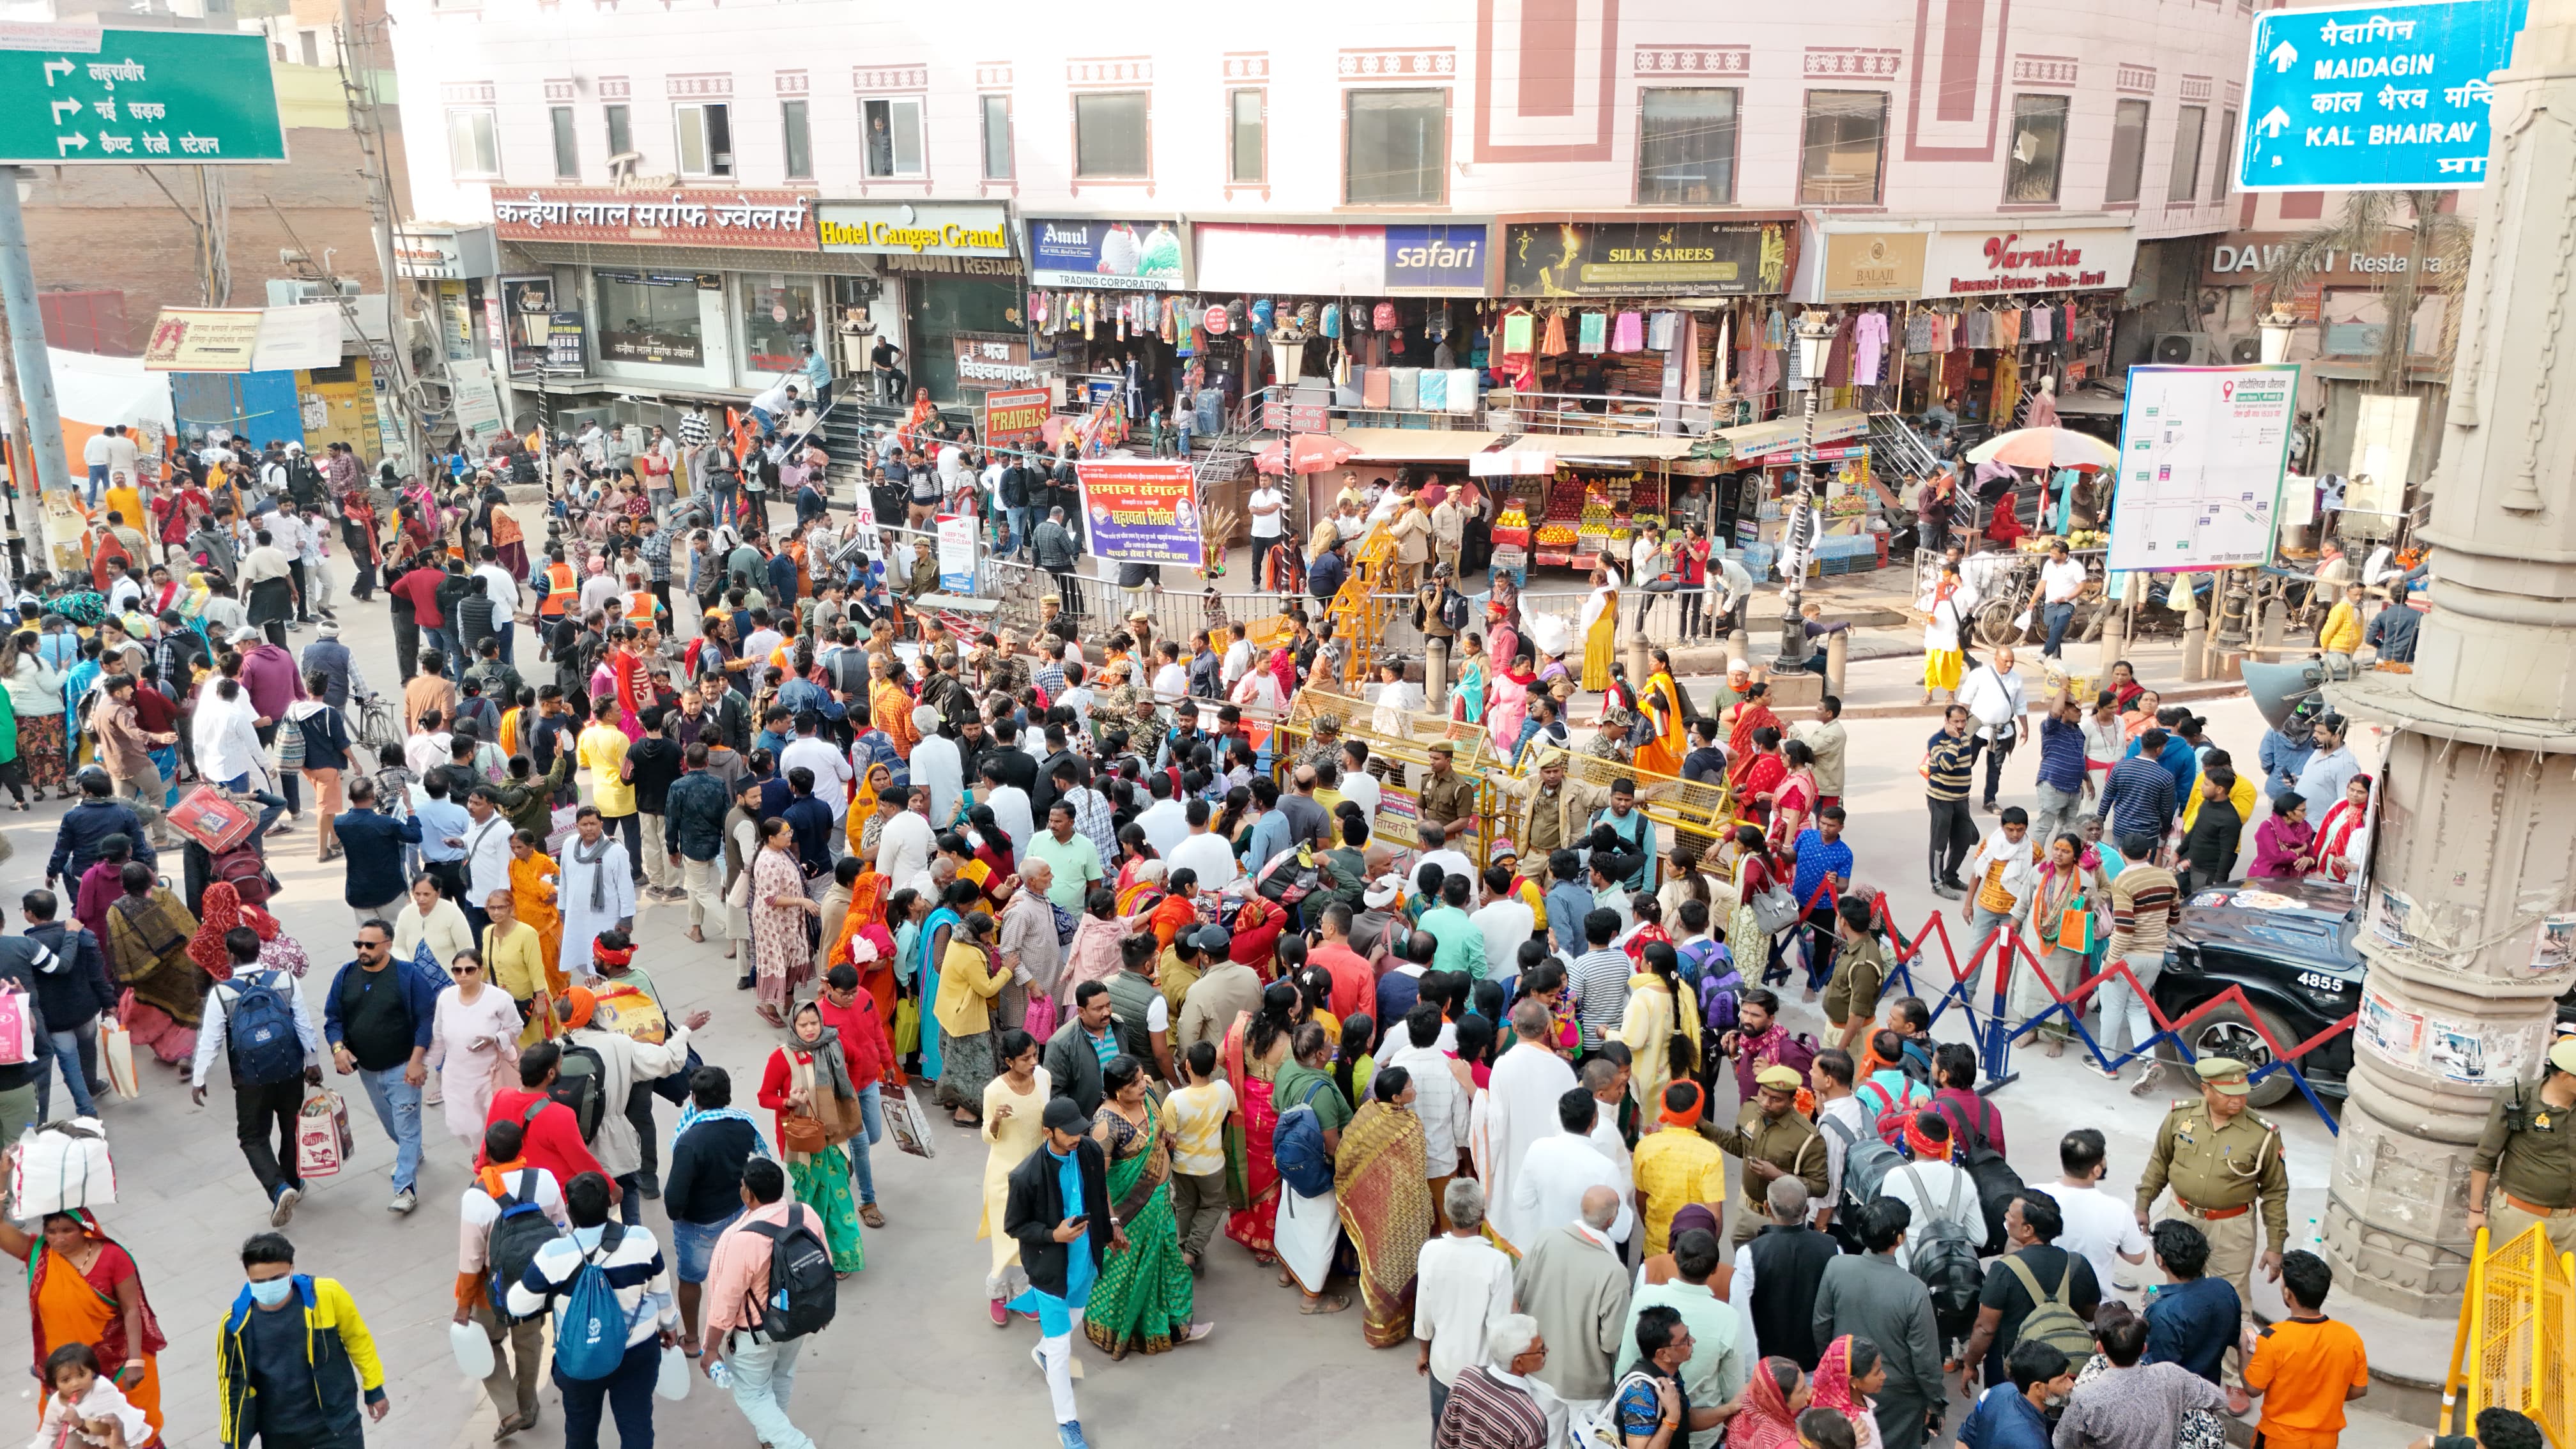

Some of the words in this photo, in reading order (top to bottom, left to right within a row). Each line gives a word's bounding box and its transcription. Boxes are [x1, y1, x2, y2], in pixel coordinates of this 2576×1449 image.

[49, 26, 100, 38] SCHEME
[2320, 15, 2416, 45] मैदागिन
[2313, 53, 2434, 80] MAIDAGIN
[93, 96, 116, 122] नई
[128, 103, 165, 123] सड़क
[2312, 91, 2362, 114] काल
[2377, 83, 2429, 111] भैरव
[2305, 126, 2356, 146] KAL
[2368, 121, 2478, 146] BHAIRAV
[495, 193, 568, 229] कन्हैया
[573, 203, 632, 226] लाल
[712, 196, 806, 231] ज्वेलर्स
[819, 220, 870, 244] Hotel
[873, 222, 939, 252] Ganges
[942, 224, 1006, 249] Grand
[1043, 224, 1087, 245] Amul
[1395, 241, 1477, 268] safari
[1609, 249, 1646, 262] SILK
[1652, 248, 1715, 261] SAREES
[1984, 234, 2082, 269] Varnika
[1059, 275, 1098, 286] TRADING
[1101, 277, 1167, 290] CORPORATION
[1857, 270, 1894, 281] BALAJI
[983, 342, 1009, 360] भज
[991, 407, 1046, 432] TRAVELS
[1307, 409, 1322, 417] नोट
[1088, 484, 1136, 495] समाज
[1140, 483, 1189, 496] संगठन
[1112, 510, 1147, 527] सहायता
[1147, 507, 1176, 526] शिविर
[2297, 971, 2343, 992] 4855
